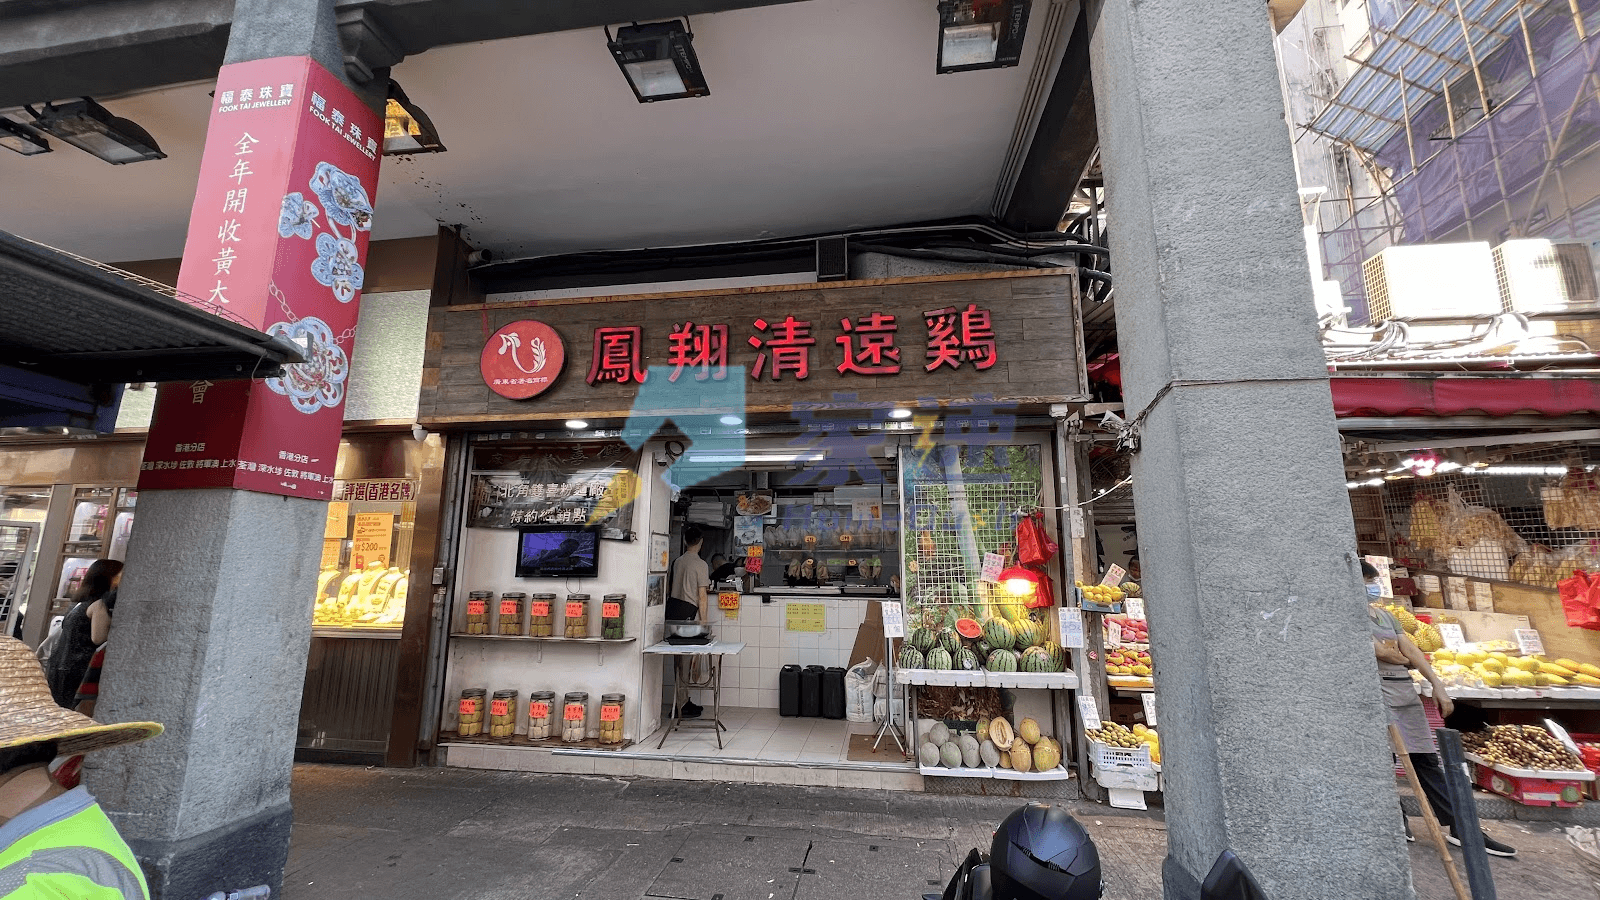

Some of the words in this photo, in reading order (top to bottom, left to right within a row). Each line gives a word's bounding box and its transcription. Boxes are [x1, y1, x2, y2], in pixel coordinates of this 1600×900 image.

[220, 83, 294, 104] 福泰珠寶
[218, 104, 239, 113] FOOK
[239, 102, 251, 110] TAI
[251, 98, 292, 108] JEWELLERY
[311, 91, 378, 155] 福泰珠寶
[309, 105, 331, 127] FOOK
[331, 121, 343, 134] TAI
[343, 129, 376, 162] JEWELLERY
[175, 442, 206, 453] 香港分店
[220, 459, 237, 468] 上水
[278, 450, 309, 465] 香港分店
[258, 463, 282, 476] 深水埗
[284, 468, 299, 479] 佐敦
[300, 471, 322, 483] 將軍澳
